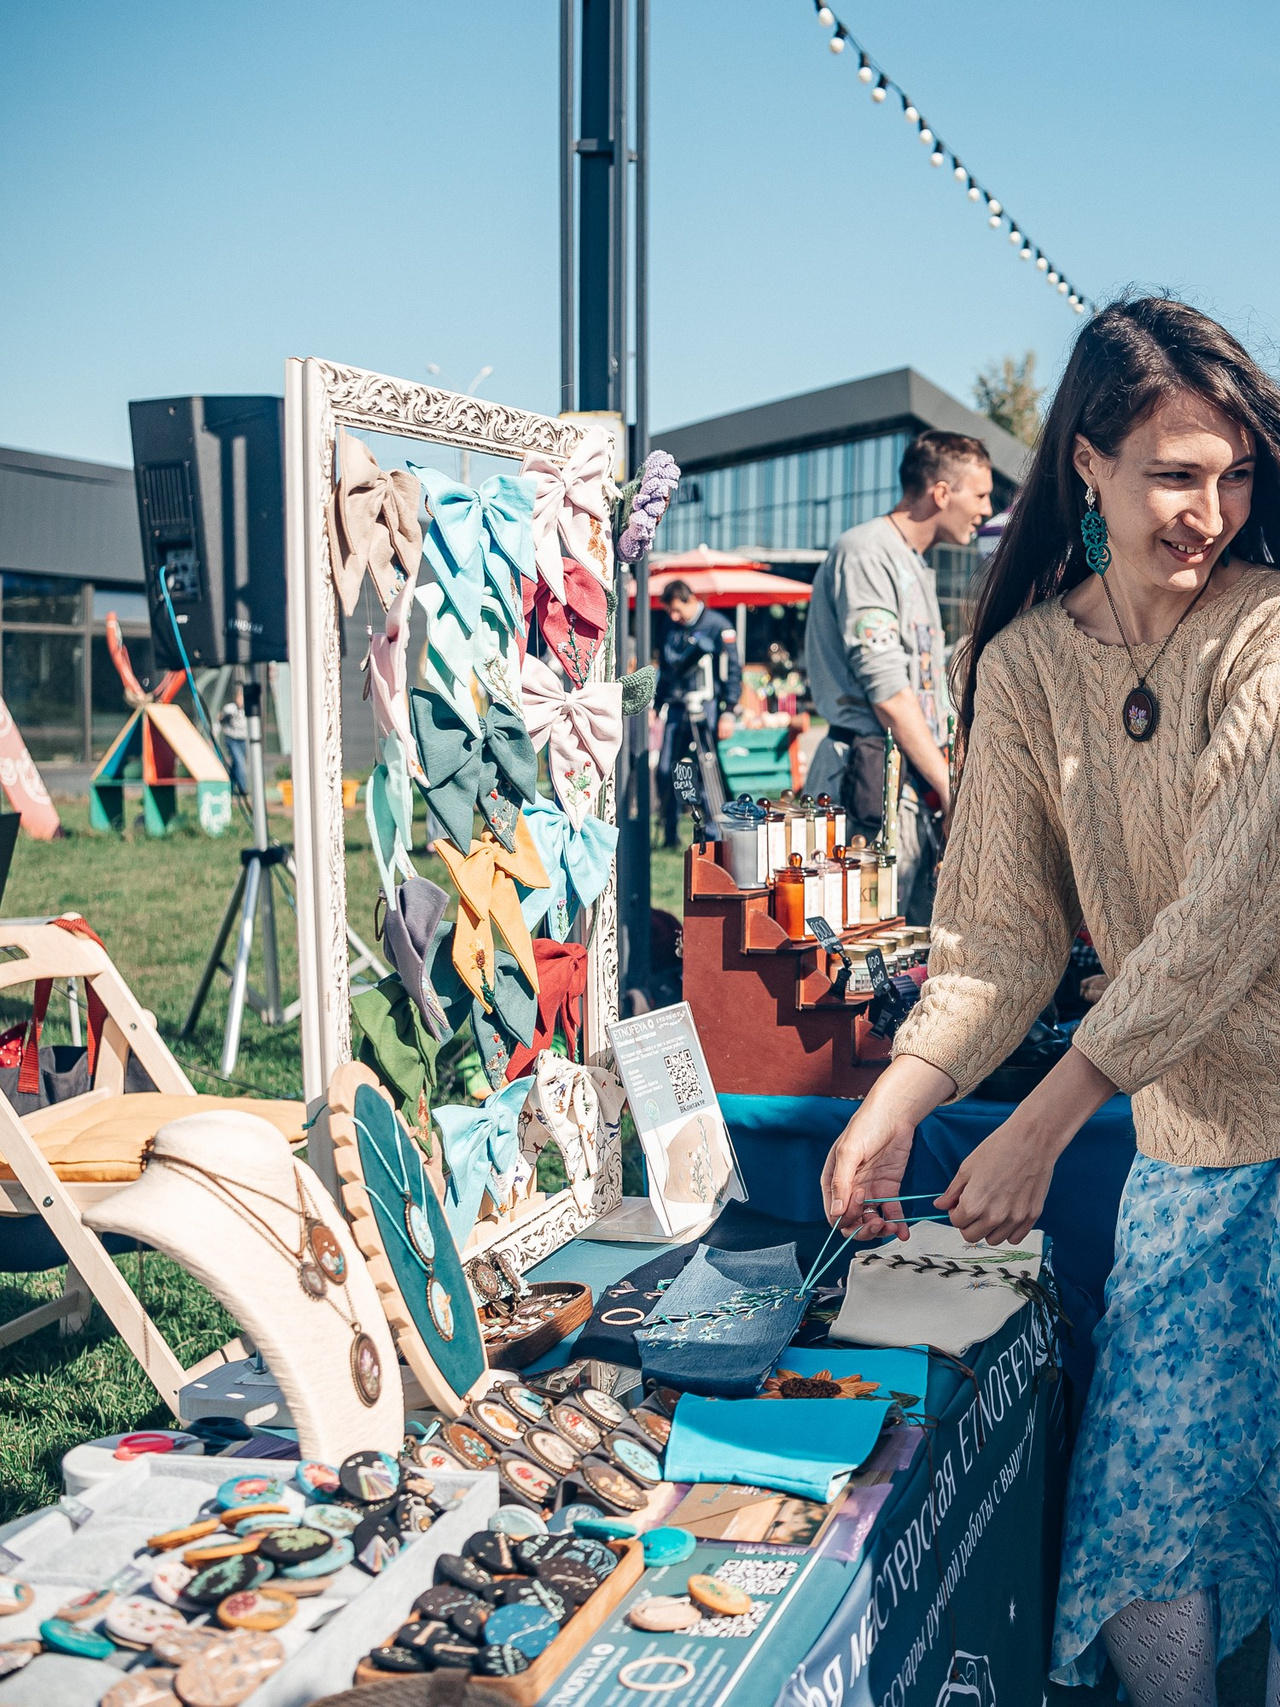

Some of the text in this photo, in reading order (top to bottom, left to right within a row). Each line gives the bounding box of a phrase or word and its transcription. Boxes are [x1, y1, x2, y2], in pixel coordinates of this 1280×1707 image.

[810, 920, 832, 940] 800
[612, 1022, 648, 1041] ETNOFEYA
[679, 1099, 706, 1114] ВКонтакте
[849, 1322, 1040, 1689] мастерская ETNOFEY
[926, 1549, 961, 1650] ручной
[959, 1491, 994, 1578] работы
